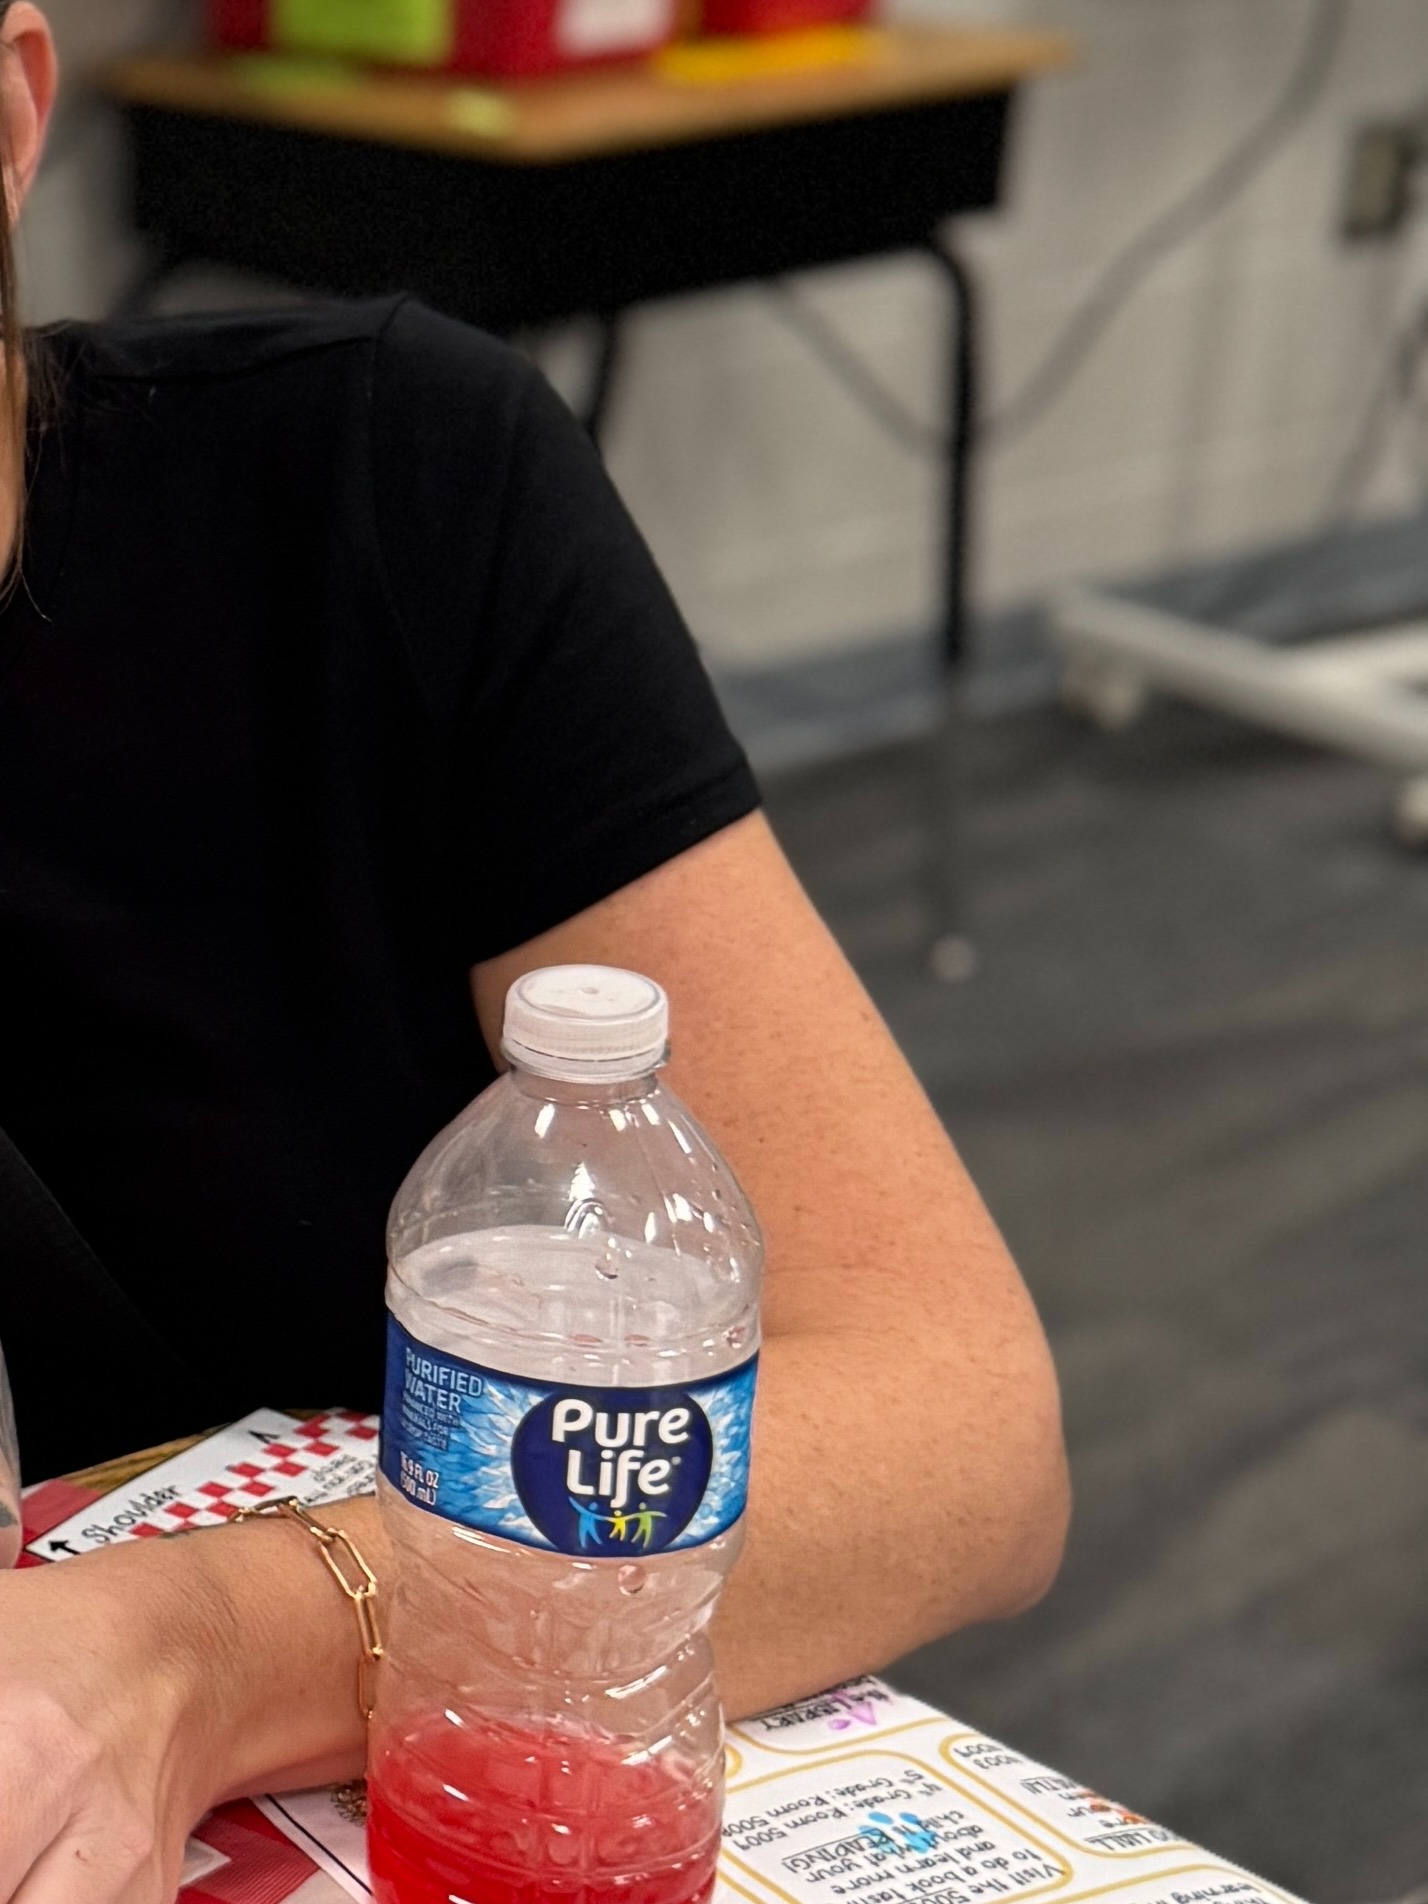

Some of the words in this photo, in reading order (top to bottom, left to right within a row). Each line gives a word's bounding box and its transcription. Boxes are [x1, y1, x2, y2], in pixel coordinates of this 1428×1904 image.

[405, 1347, 483, 1398] PURIFIED
[404, 1368, 460, 1412] WATER
[552, 1398, 691, 1447] Pure
[414, 1463, 424, 1483] FL
[425, 1469, 439, 1488] OZ
[565, 1449, 669, 1508] Life
[416, 1487, 436, 1505] mL)
[758, 1694, 851, 1731] LIBRARY
[826, 1776, 894, 1797] Grade:
[843, 1786, 911, 1811] Grade:
[769, 1794, 828, 1816] Room
[783, 1806, 846, 1830] Room
[732, 1827, 787, 1850] 5009
[956, 1838, 996, 1859] and
[780, 1828, 890, 1874] READING!
[895, 1851, 958, 1875] learn
[1011, 1848, 1041, 1861] to
[804, 1859, 857, 1883] your
[961, 1865, 975, 1878] a
[980, 1856, 1008, 1872] do
[1007, 1862, 1064, 1886] Visit
[830, 1870, 894, 1894] more
[905, 1870, 961, 1894] book
[968, 1874, 1007, 1894] the
